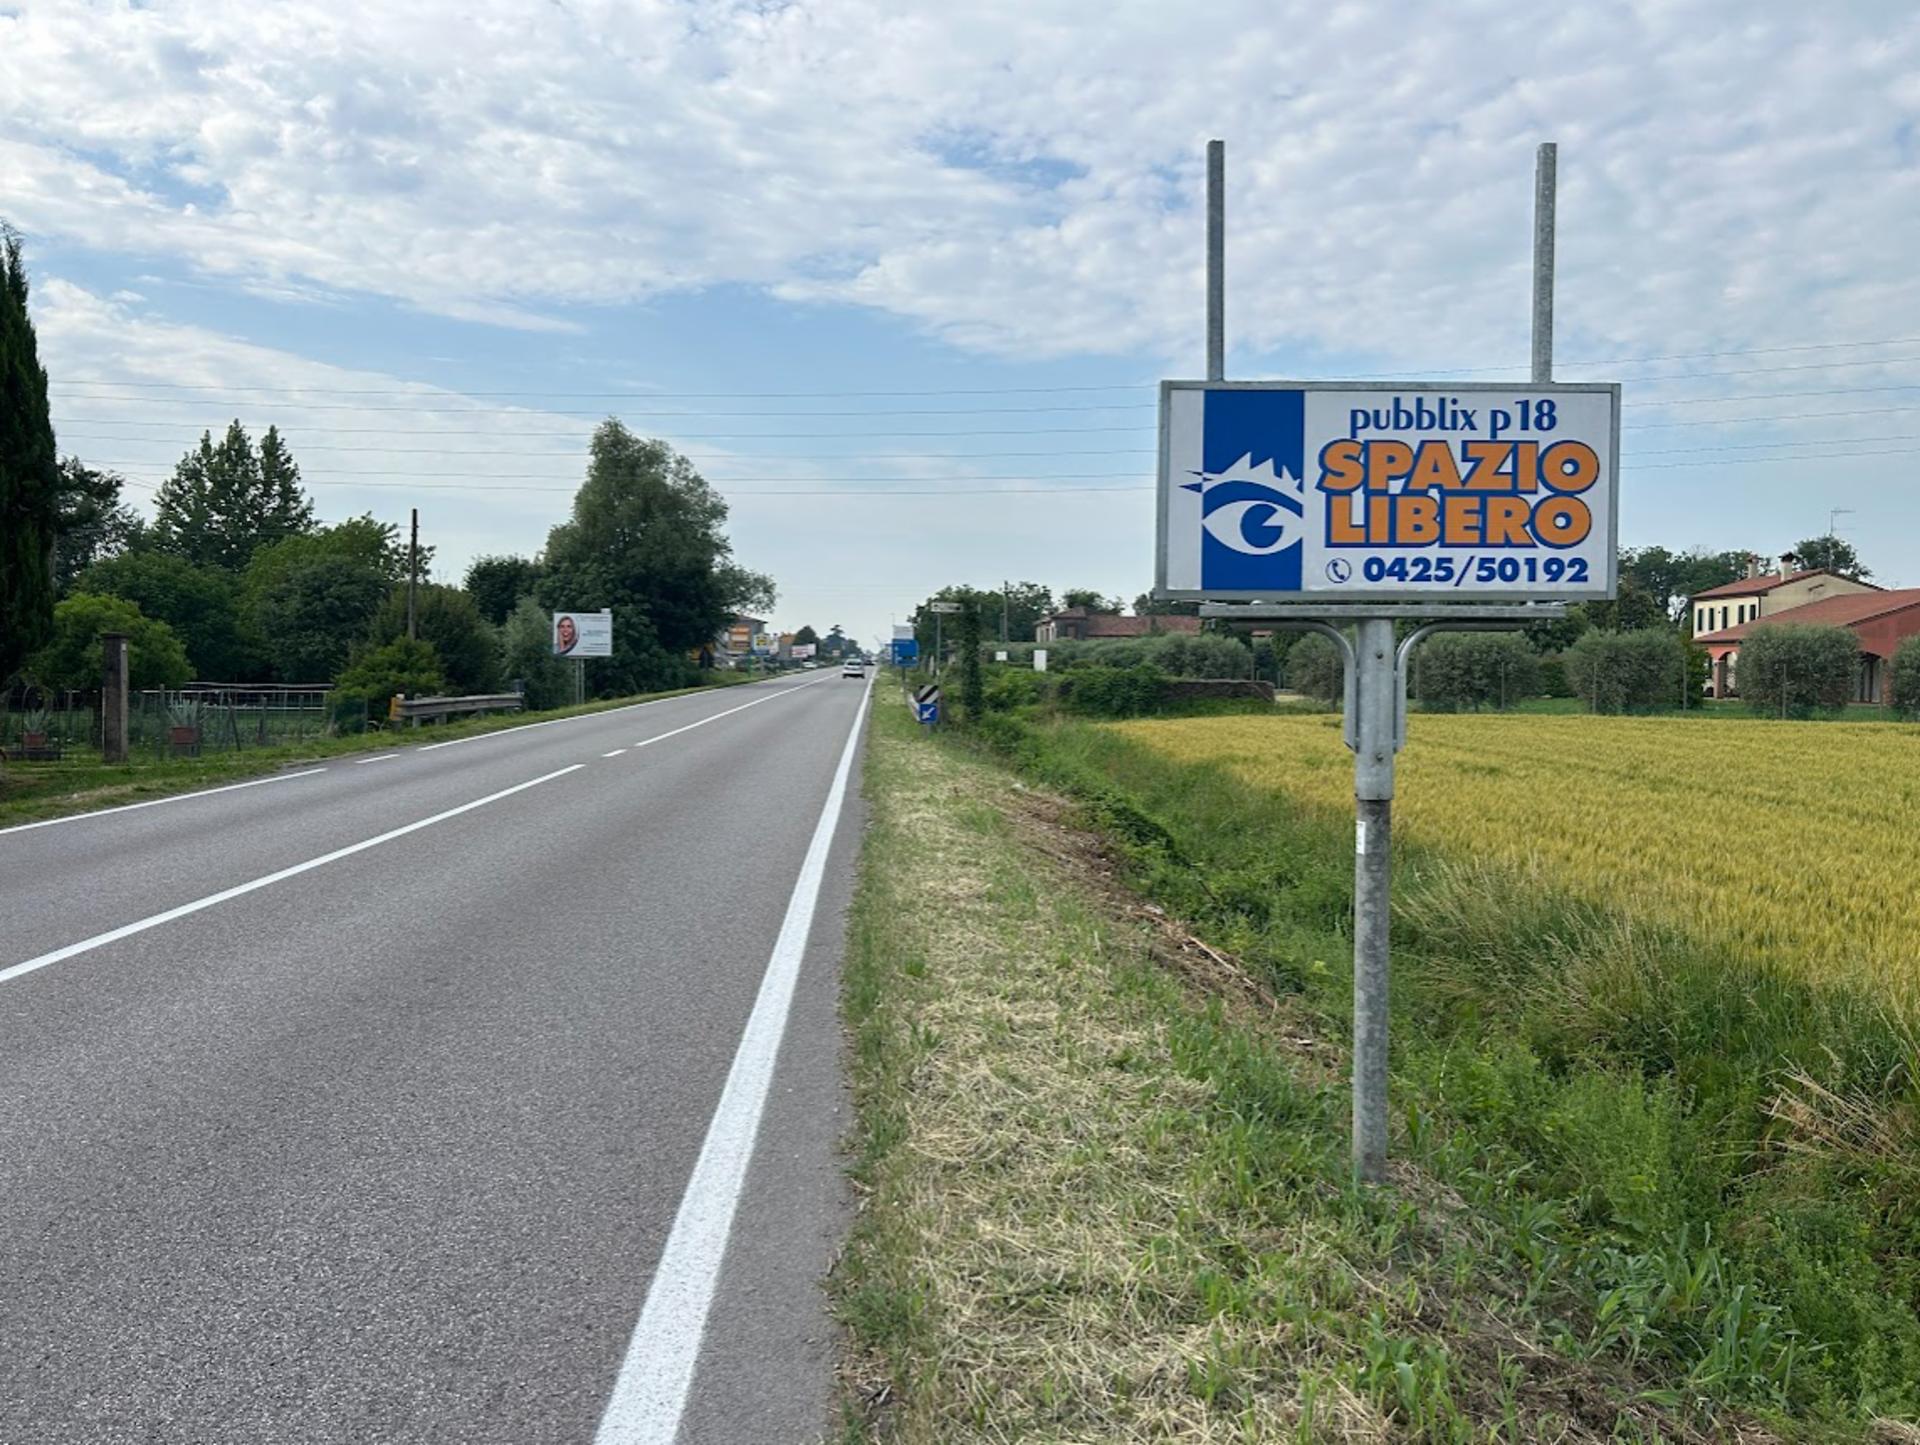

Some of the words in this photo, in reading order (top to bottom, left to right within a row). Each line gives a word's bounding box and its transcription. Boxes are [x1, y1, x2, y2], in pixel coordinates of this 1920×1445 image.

[1350, 396, 1477, 438] pubblix
[1315, 438, 1600, 495] SPAZIO
[1325, 493, 1592, 549] LIBERO
[1363, 555, 1588, 586] 0425/50192
